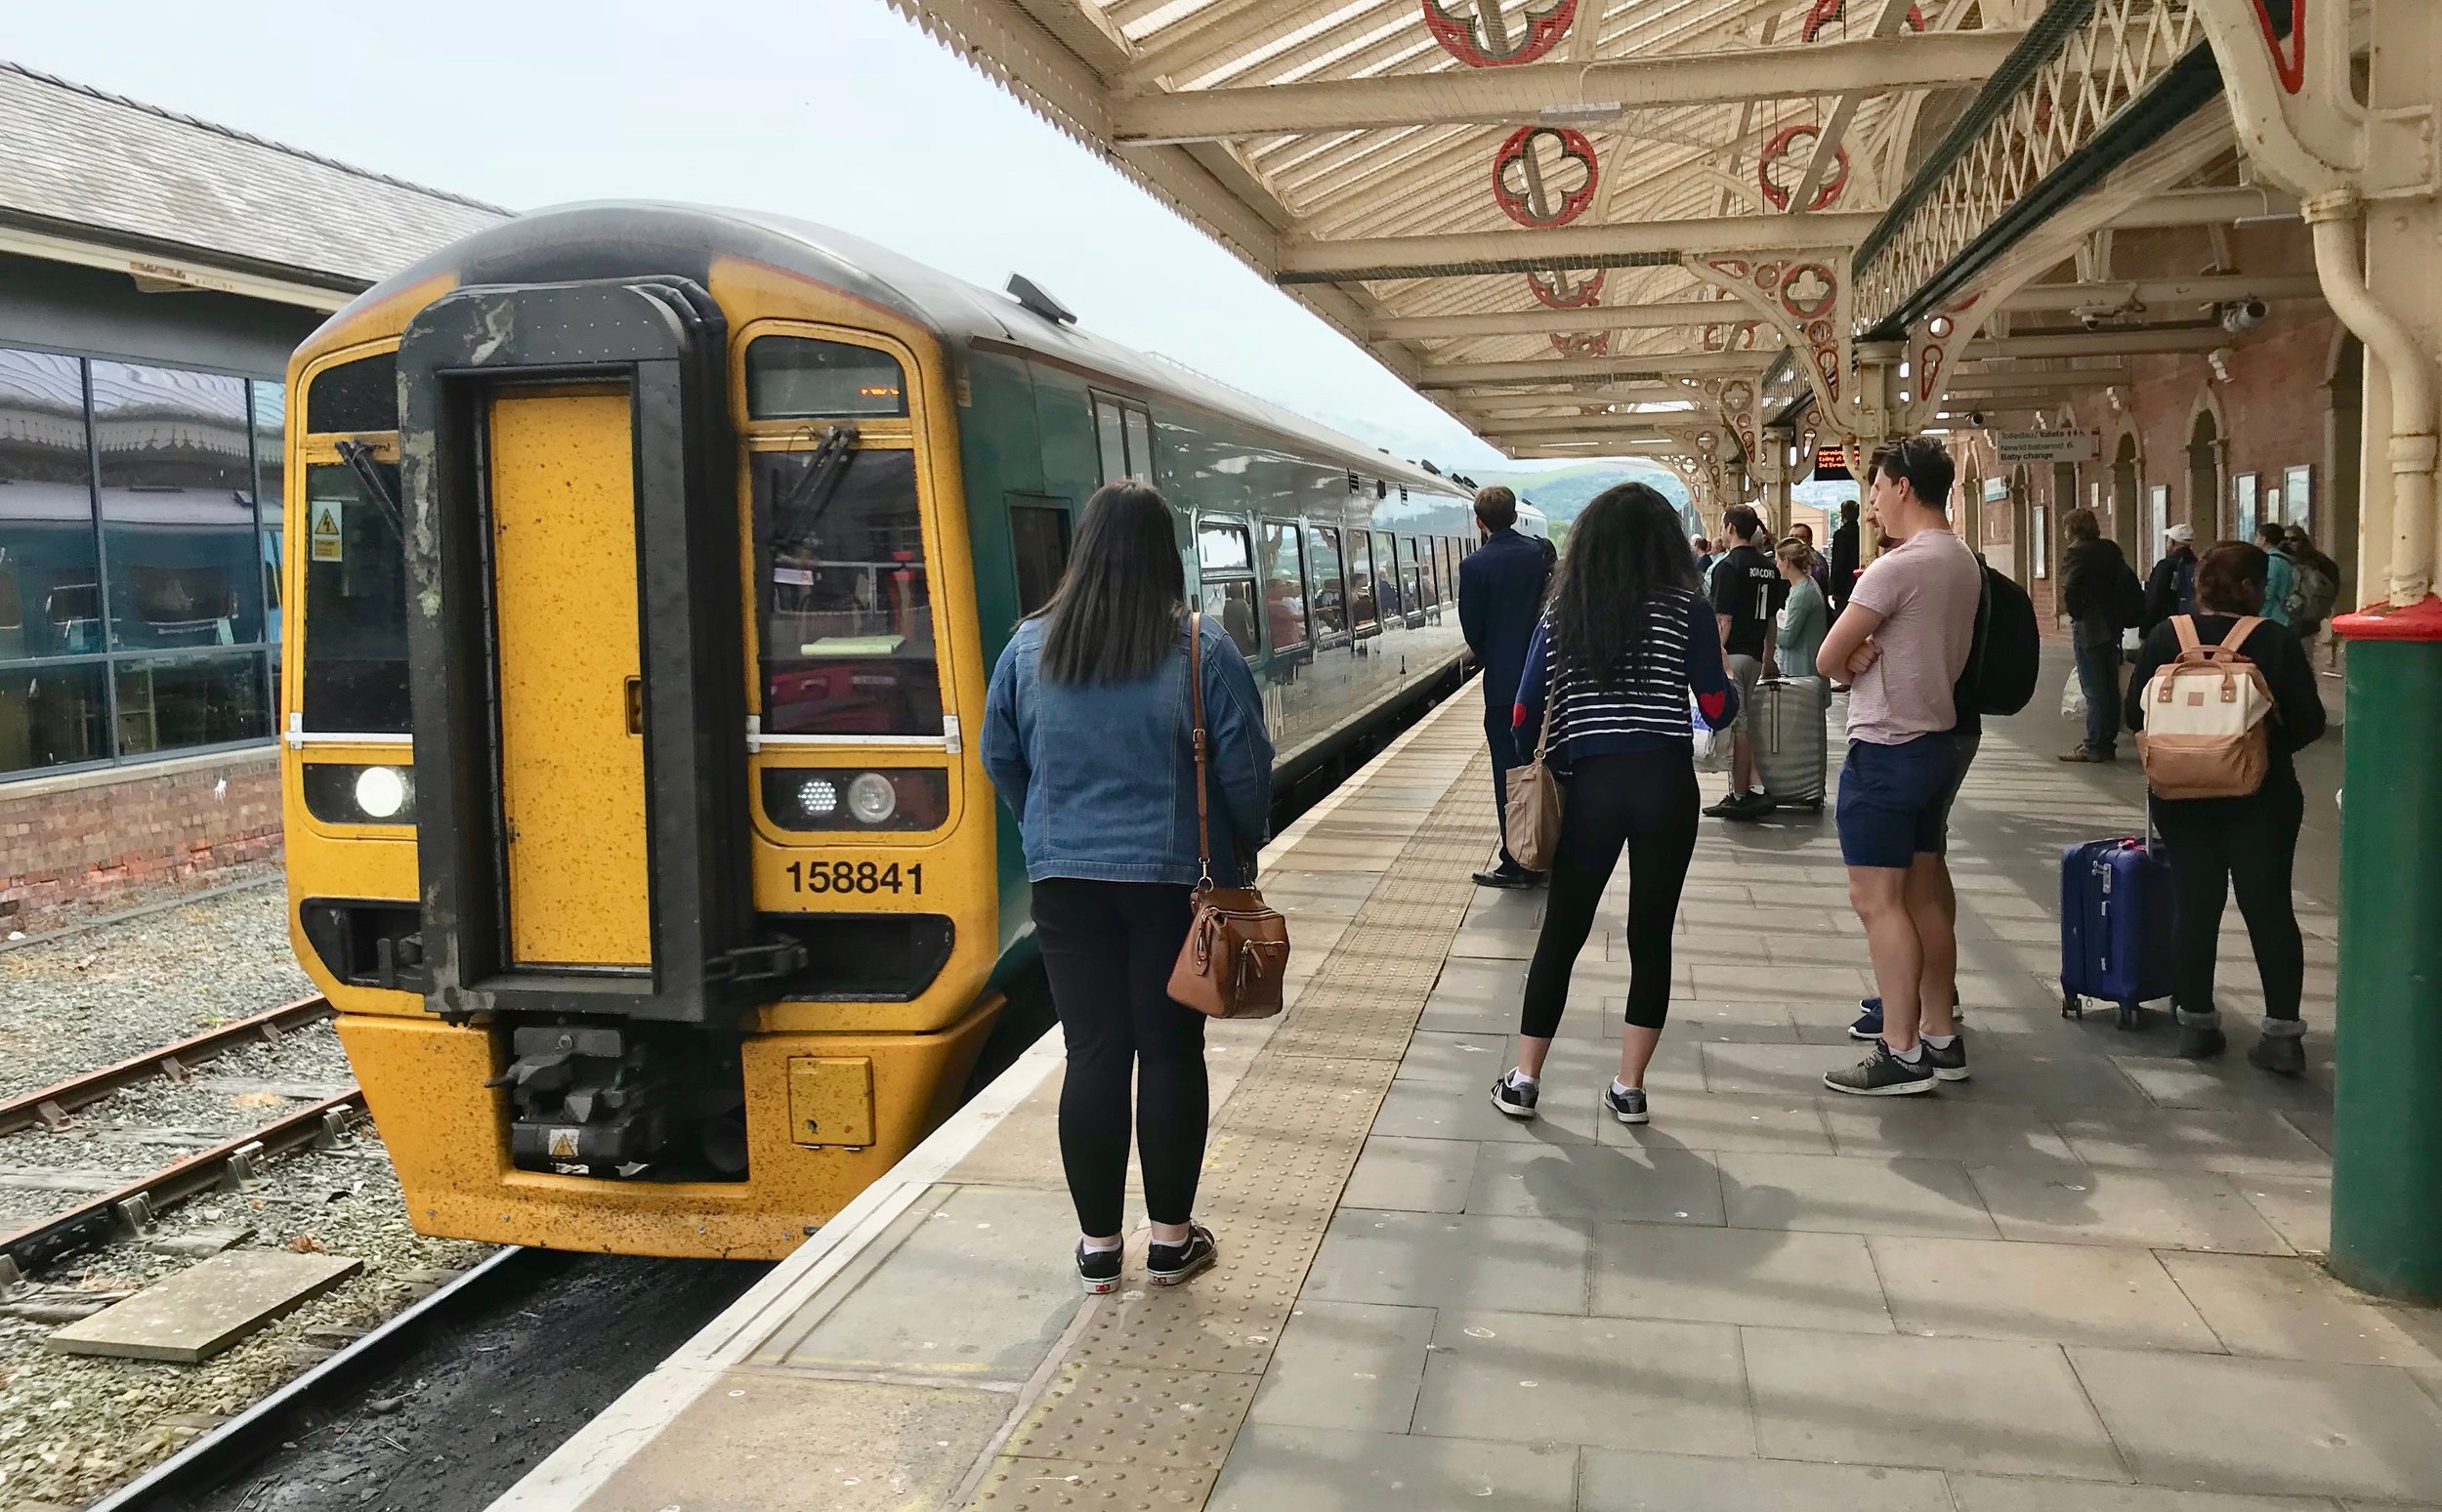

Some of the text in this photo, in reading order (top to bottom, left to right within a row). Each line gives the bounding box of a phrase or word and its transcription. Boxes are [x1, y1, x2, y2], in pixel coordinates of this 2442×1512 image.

[2000, 452, 2054, 462] Baby change
[785, 861, 922, 895] 158841
